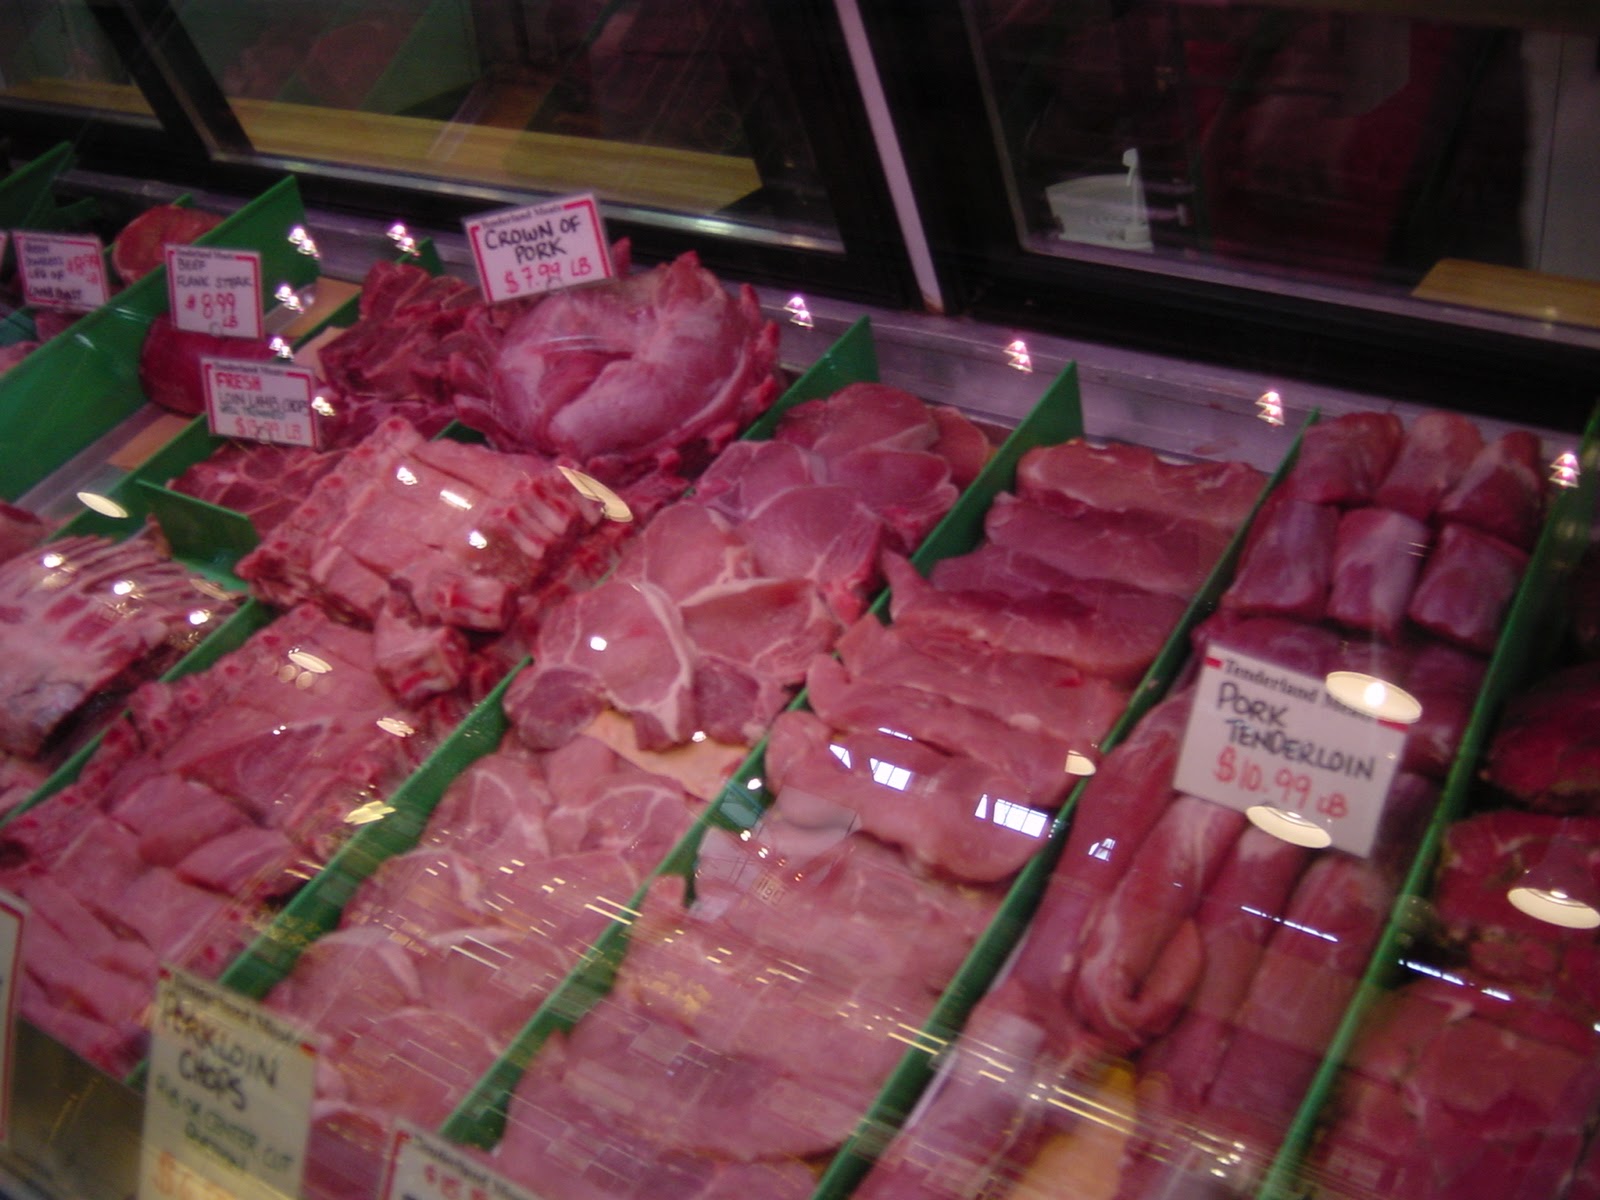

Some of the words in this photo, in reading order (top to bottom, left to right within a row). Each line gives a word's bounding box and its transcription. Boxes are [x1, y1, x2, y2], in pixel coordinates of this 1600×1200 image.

[484, 219, 554, 250] CROWN
[559, 214, 582, 234] OF
[514, 237, 568, 264] PORK
[570, 256, 593, 277] LB
[216, 372, 262, 391] FRESH
[1223, 657, 1319, 704] Tenderland
[1216, 681, 1290, 728] PORK
[1225, 716, 1377, 781] TENDERLOIN
[1213, 745, 1313, 809] $10.99
